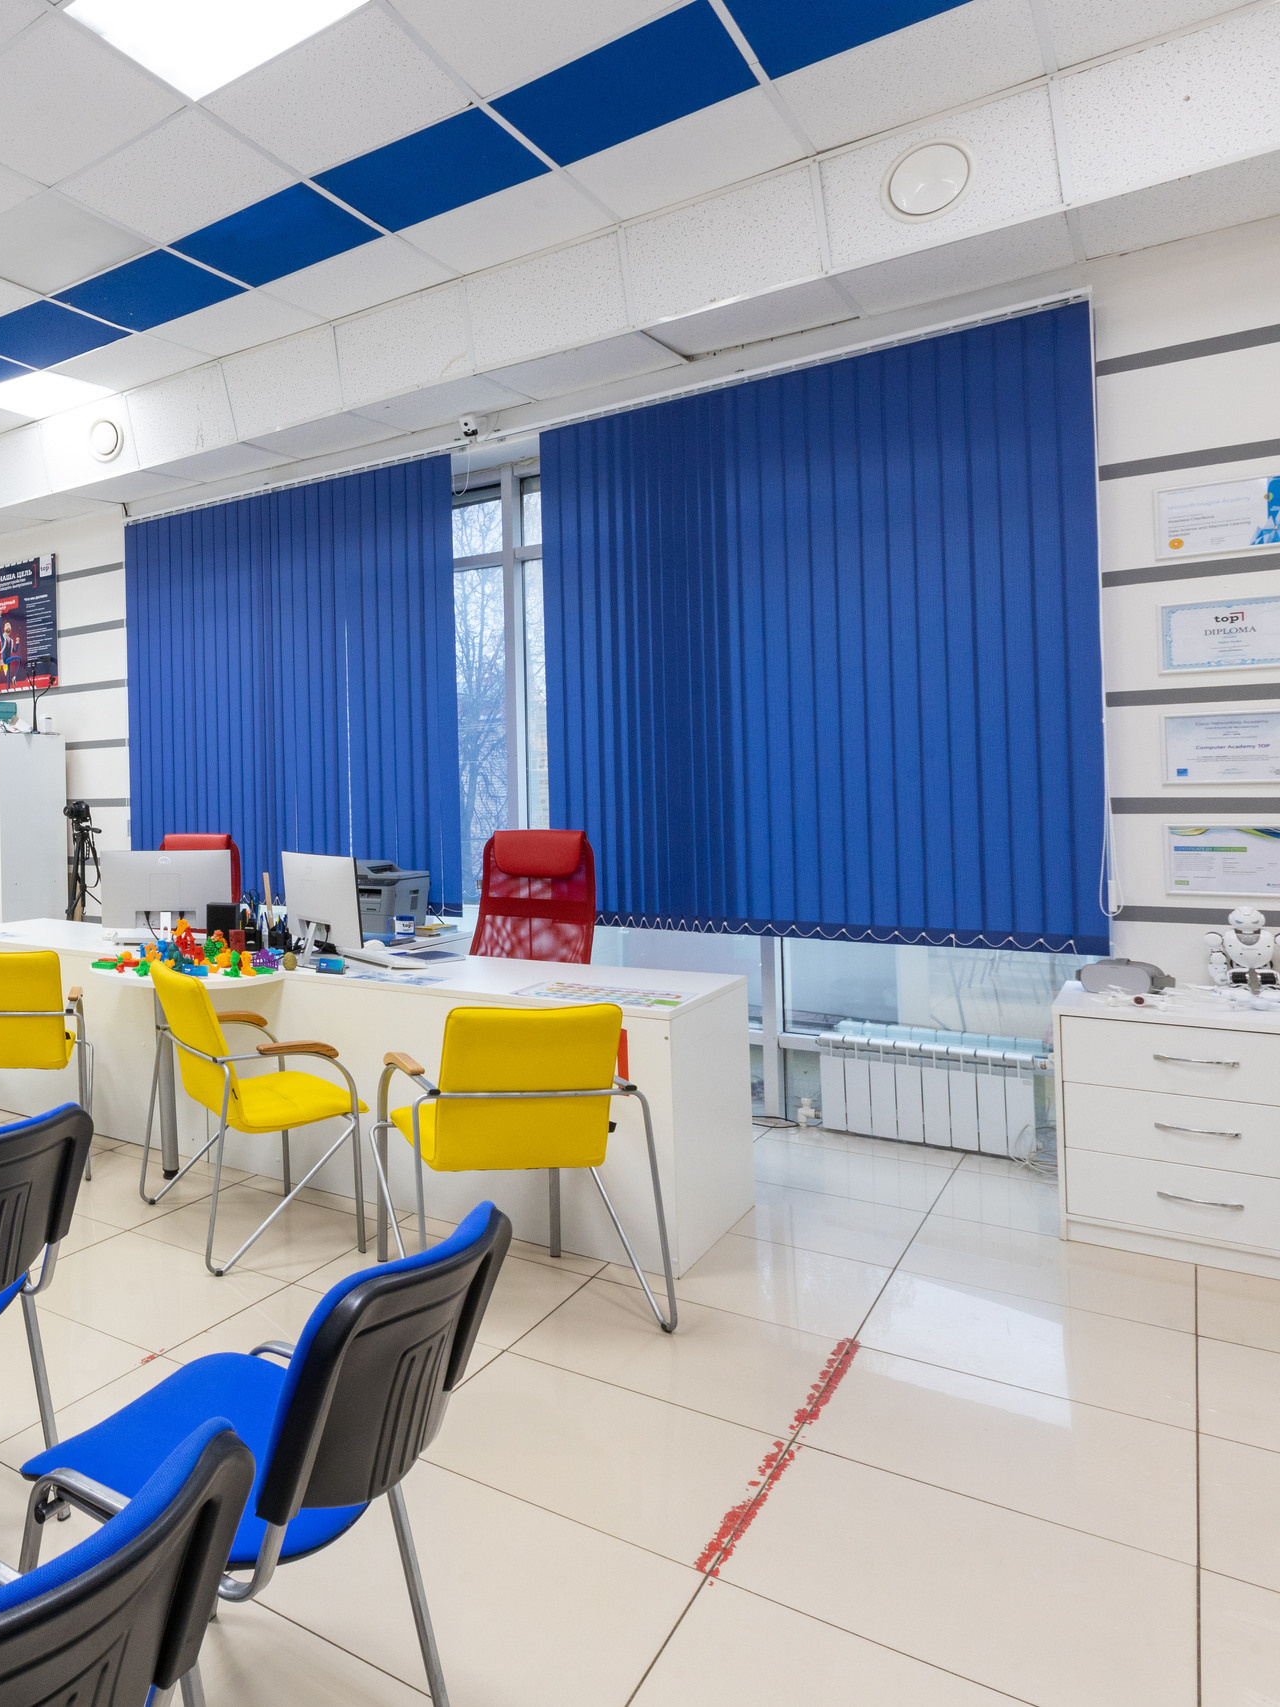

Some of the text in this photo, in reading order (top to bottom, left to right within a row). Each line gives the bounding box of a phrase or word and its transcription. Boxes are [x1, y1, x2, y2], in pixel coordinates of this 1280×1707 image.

[16, 569, 32, 578] ЦЕЛЬ
[1214, 615, 1239, 624] top
[1204, 626, 1257, 636] DIPLOMA
